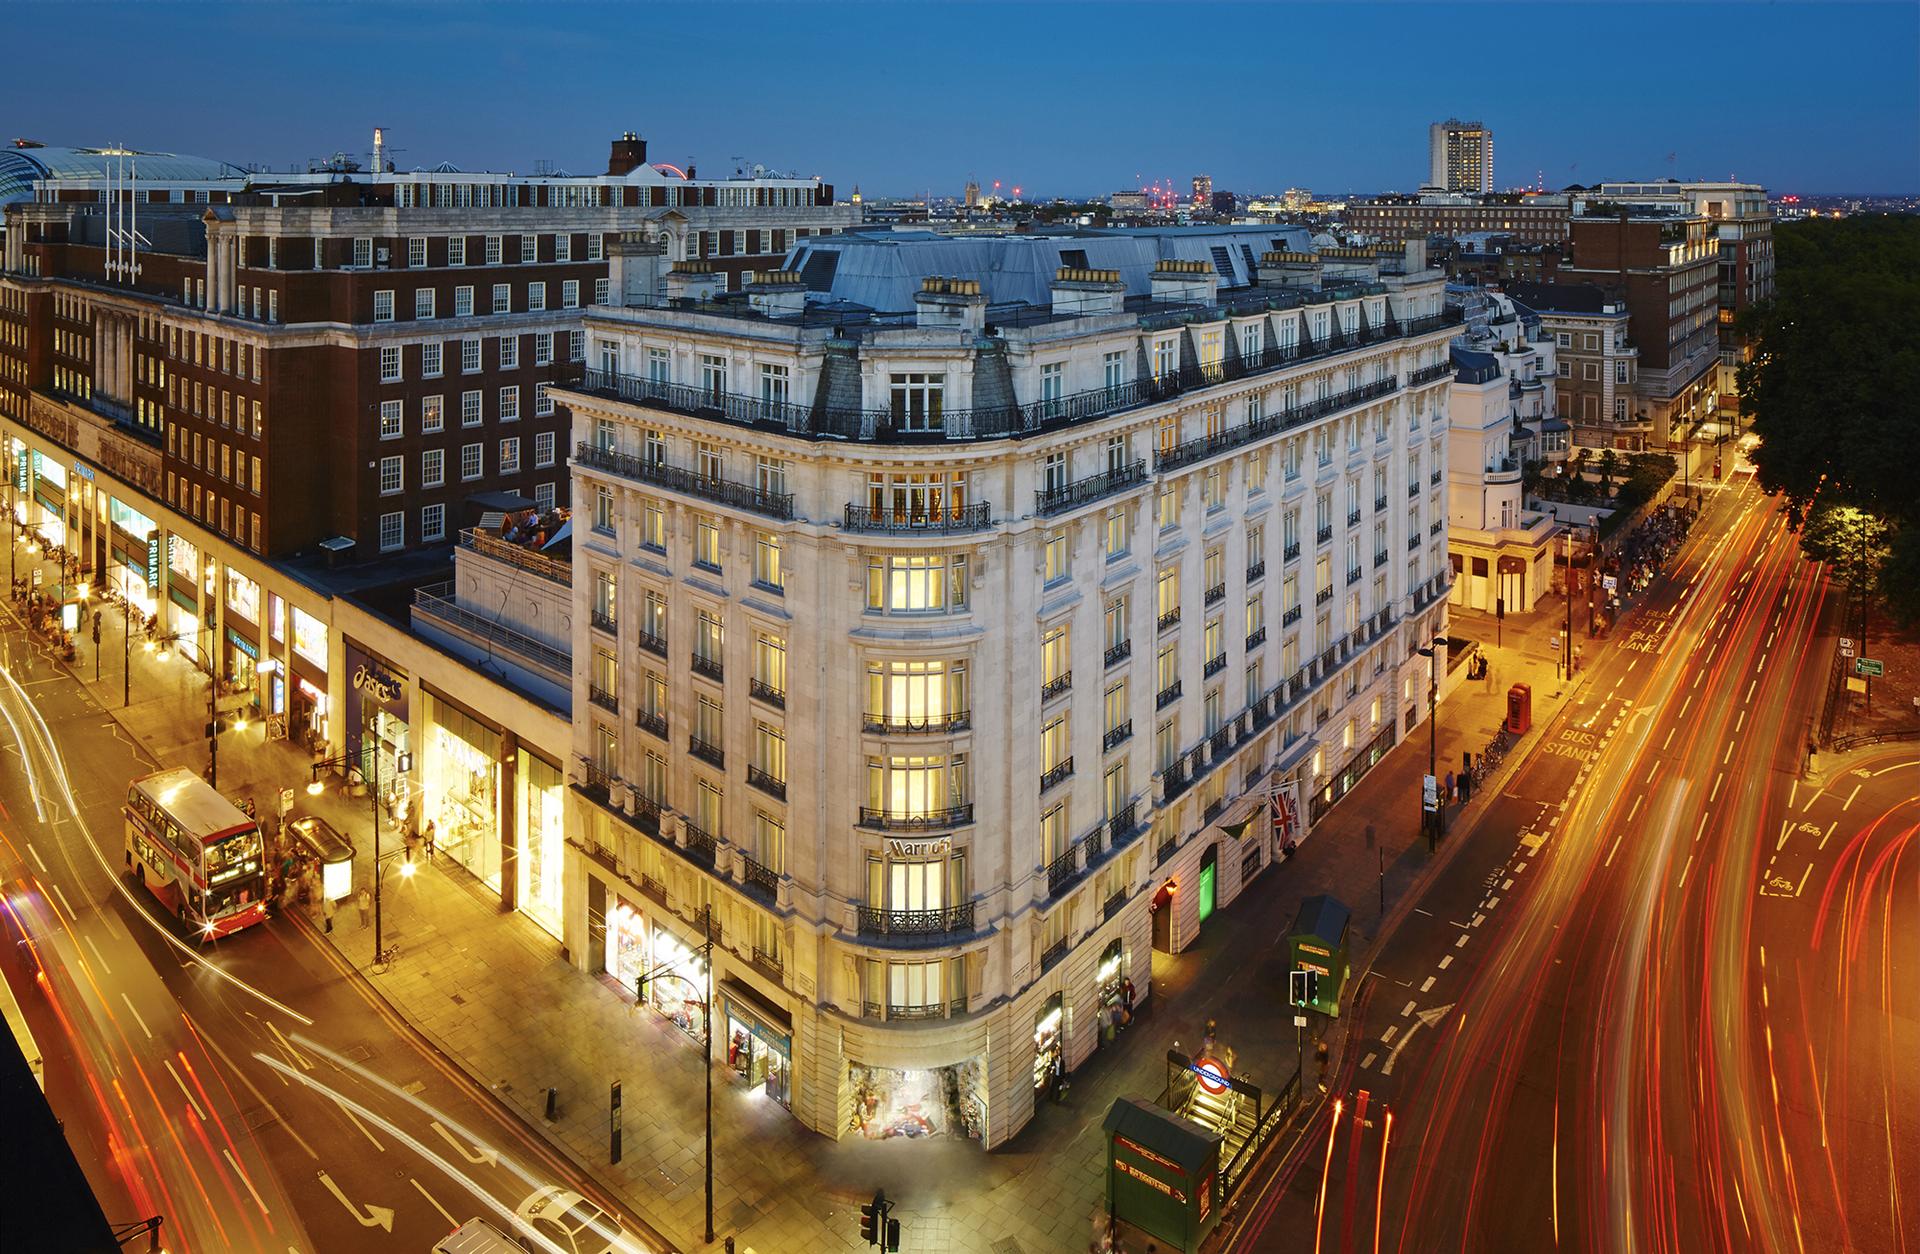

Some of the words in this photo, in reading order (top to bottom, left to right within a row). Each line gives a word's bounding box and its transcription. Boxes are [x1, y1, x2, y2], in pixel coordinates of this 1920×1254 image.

[19, 456, 27, 493] PRIMARK
[148, 539, 158, 589] PRIMARK
[1646, 609, 1671, 619] BUS
[1630, 631, 1661, 643] BUS
[1617, 640, 1655, 654] LANE
[1560, 729, 1595, 745] BUS
[1543, 742, 1592, 761] STAND
[1193, 1066, 1230, 1087] UNDERGROUND
